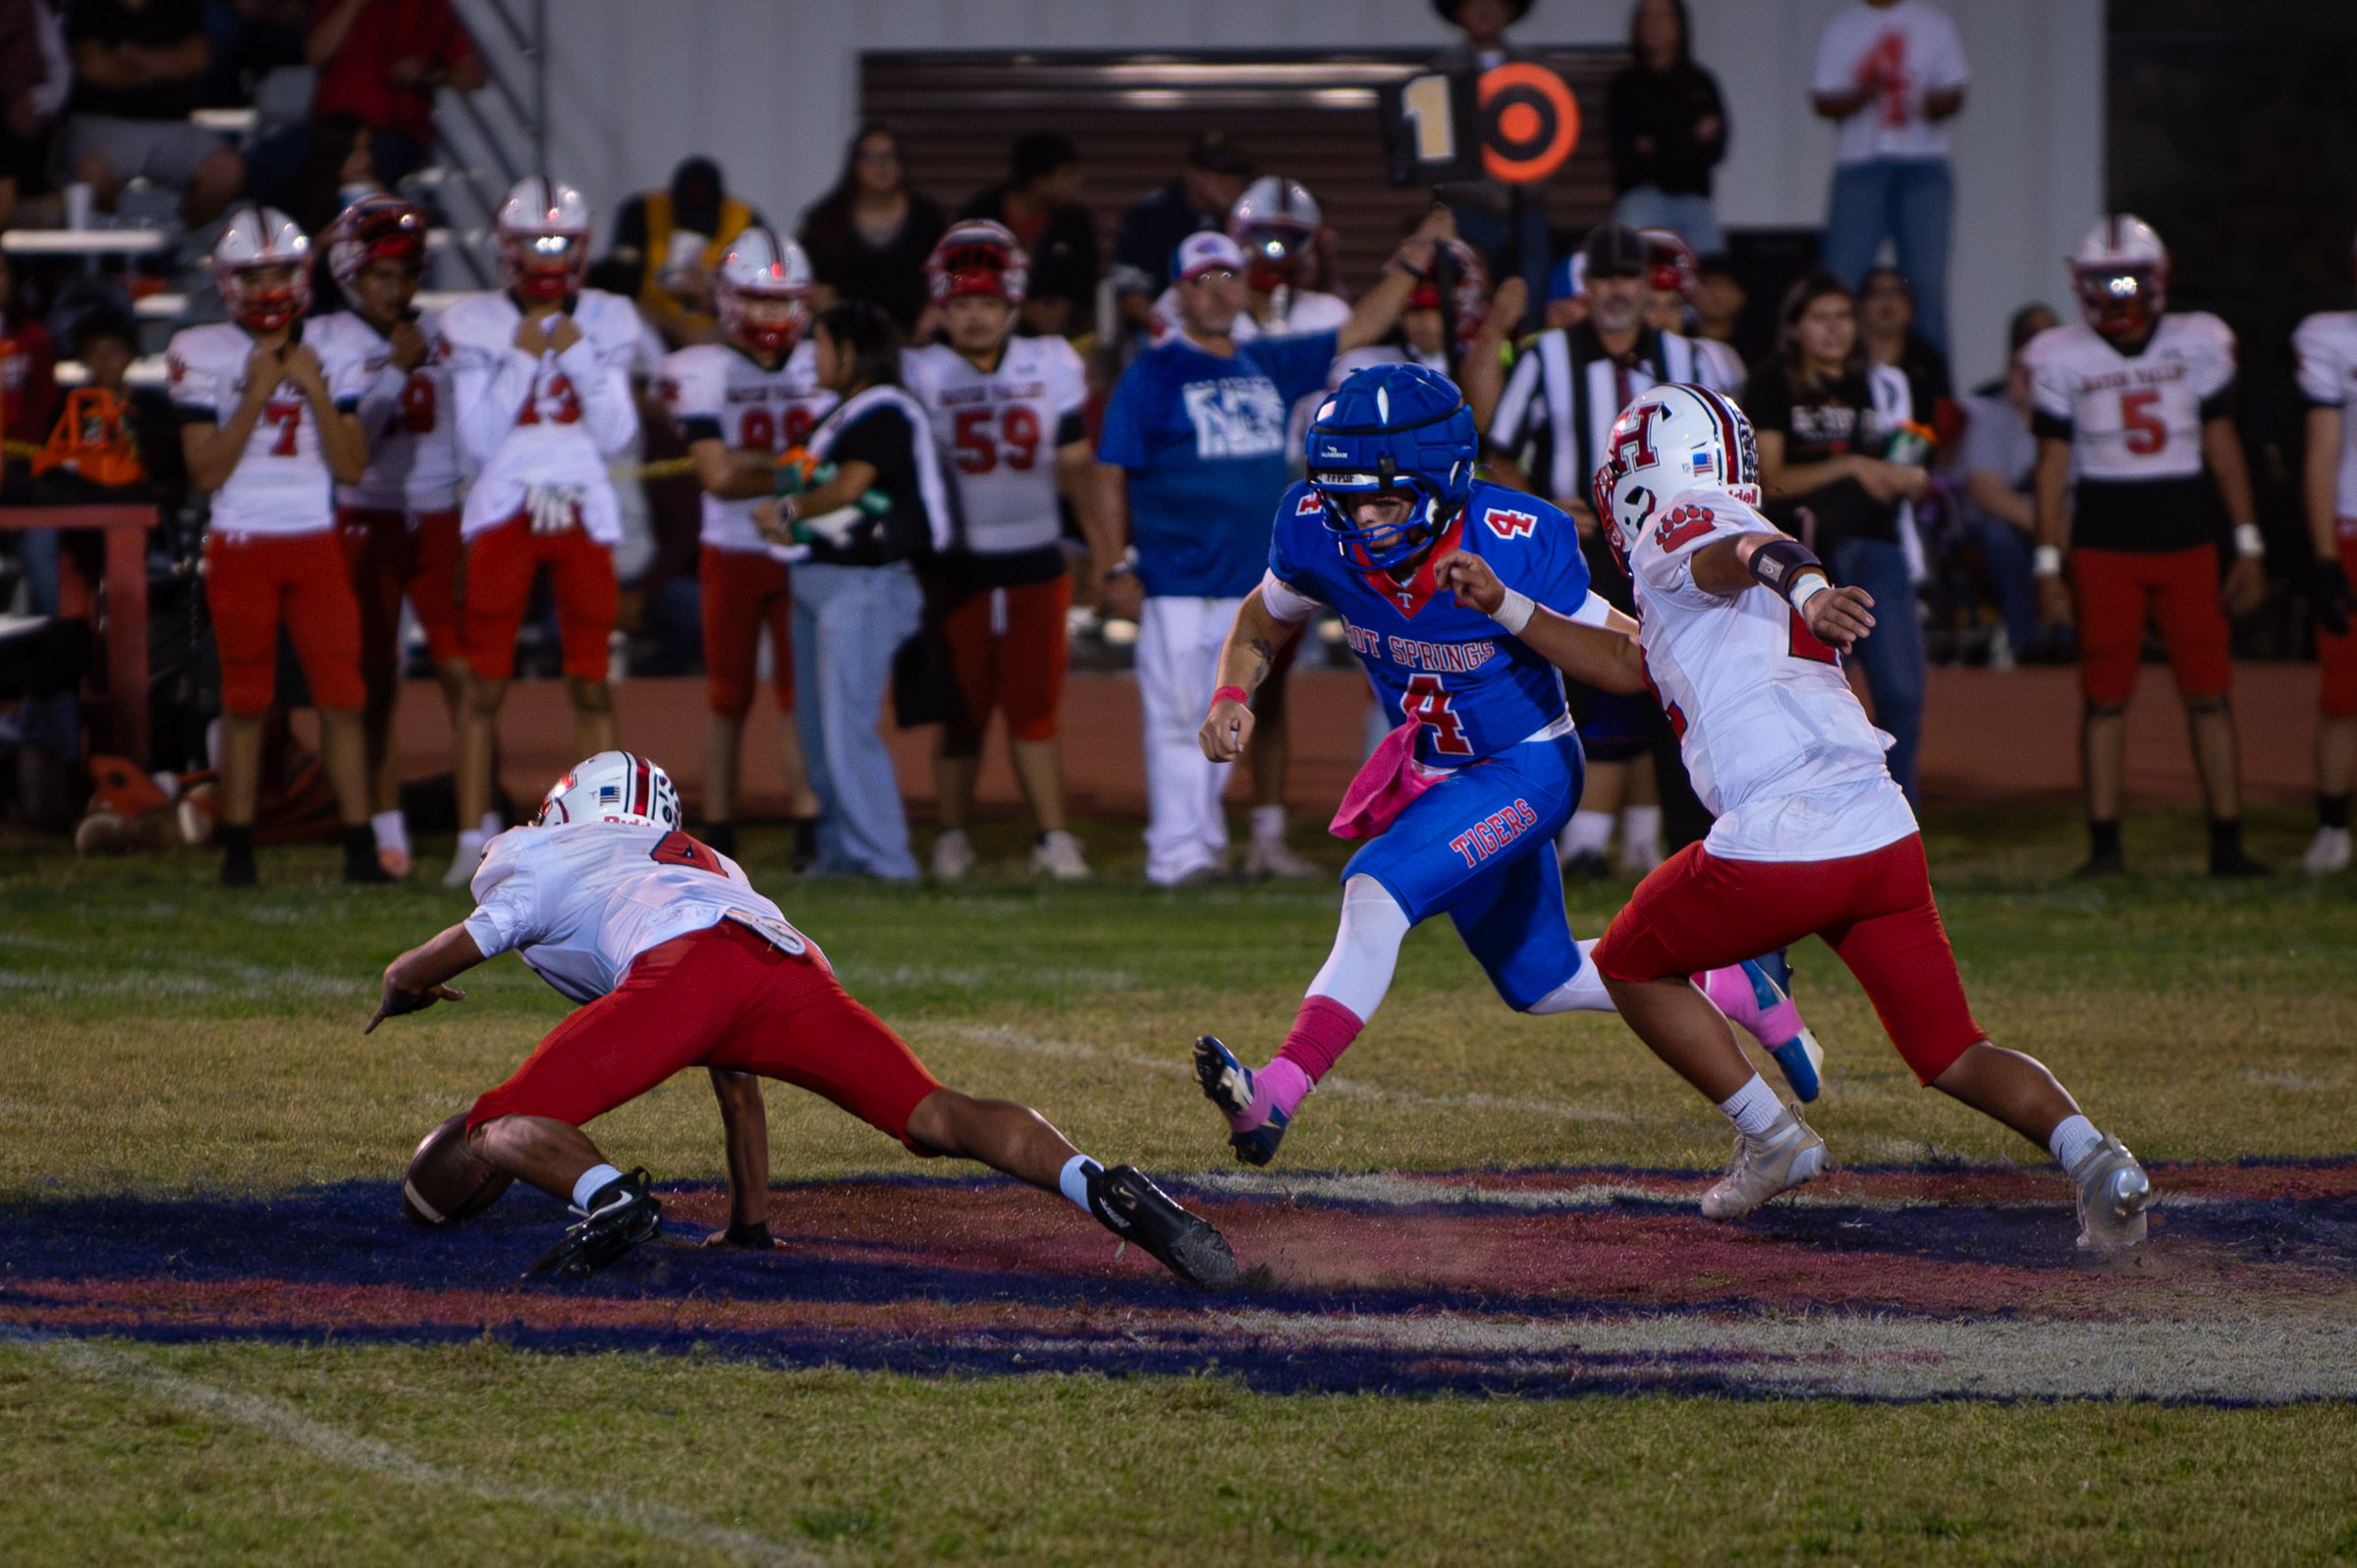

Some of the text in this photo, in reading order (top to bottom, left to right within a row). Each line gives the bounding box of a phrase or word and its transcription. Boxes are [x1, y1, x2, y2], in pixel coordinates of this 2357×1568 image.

[1401, 74, 1456, 165] 1
[264, 403, 301, 456] 7
[955, 404, 1041, 473] 59
[1612, 401, 1665, 478] H
[2121, 390, 2167, 454] 5
[1484, 508, 1538, 540] 4
[1396, 592, 1414, 610] T
[1388, 635, 1496, 674] SPRINGS
[1399, 673, 1475, 756] 4
[1449, 797, 1538, 869] TIGERS
